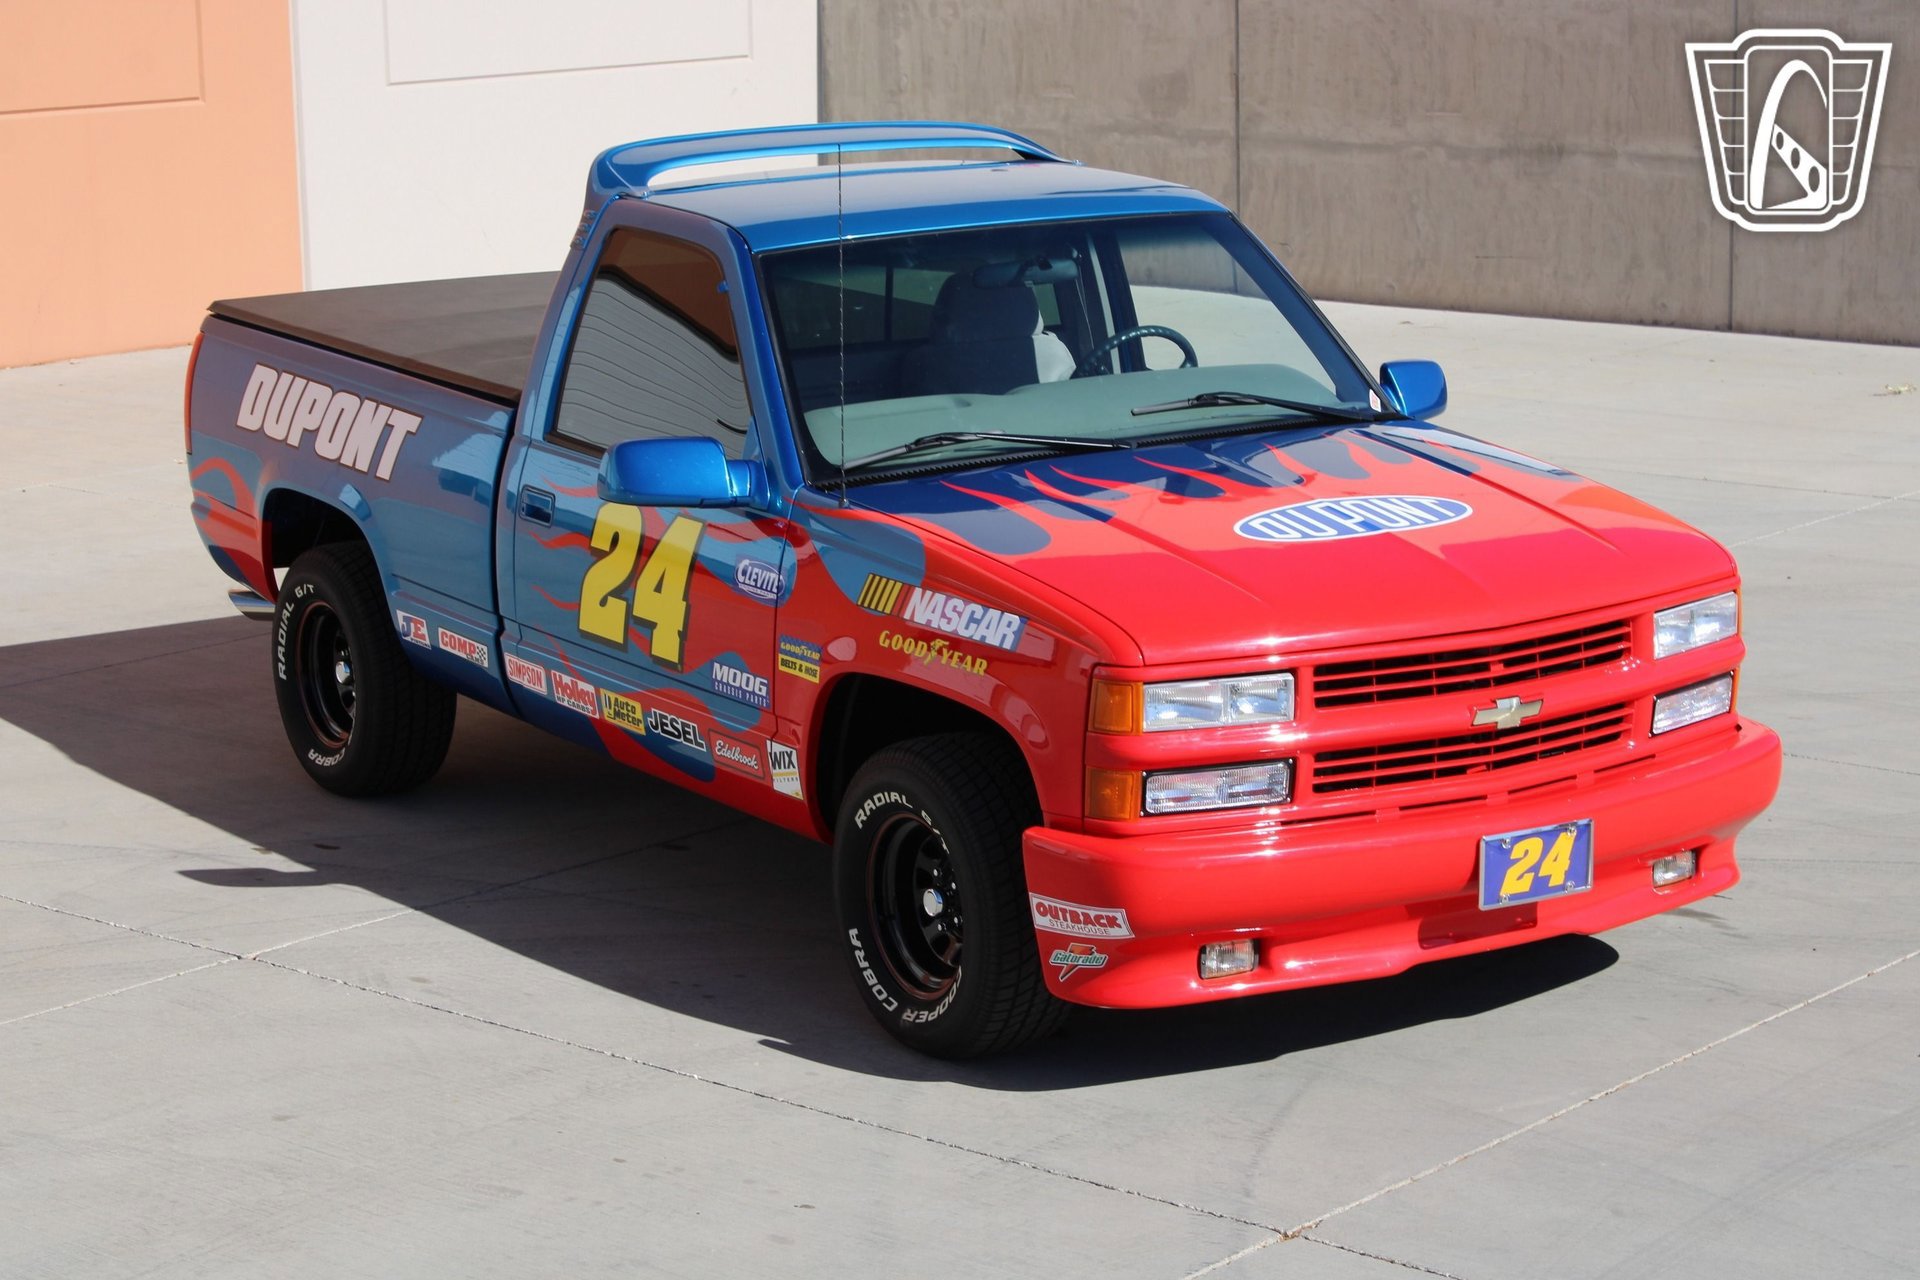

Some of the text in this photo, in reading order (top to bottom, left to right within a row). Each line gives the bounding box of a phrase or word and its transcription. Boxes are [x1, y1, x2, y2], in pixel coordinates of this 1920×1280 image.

[236, 363, 423, 481] DUPONT
[578, 501, 704, 672] 24
[736, 558, 779, 593] CLEVITE
[278, 583, 314, 680] RADIAL G/T
[401, 615, 426, 642] JE
[903, 586, 1021, 650] NASCAR
[440, 630, 477, 656] COMP
[508, 658, 543, 689] SIMPSON
[712, 662, 768, 698] MOOG
[552, 672, 597, 716] Holley
[614, 697, 636, 714] Auto
[714, 681, 767, 708] CHASSIS PARTS
[613, 708, 642, 727] Meter
[648, 709, 706, 752] JESEL
[715, 740, 759, 770] Edelbrock
[769, 750, 797, 770] WIX
[854, 791, 913, 829] RADIAL
[1500, 832, 1577, 896] 24
[1035, 901, 1122, 928] OUTBACK
[1049, 918, 1109, 936] STEAKHOUSE
[848, 928, 898, 1012] COBRA
[1053, 952, 1105, 964] Gatorade
